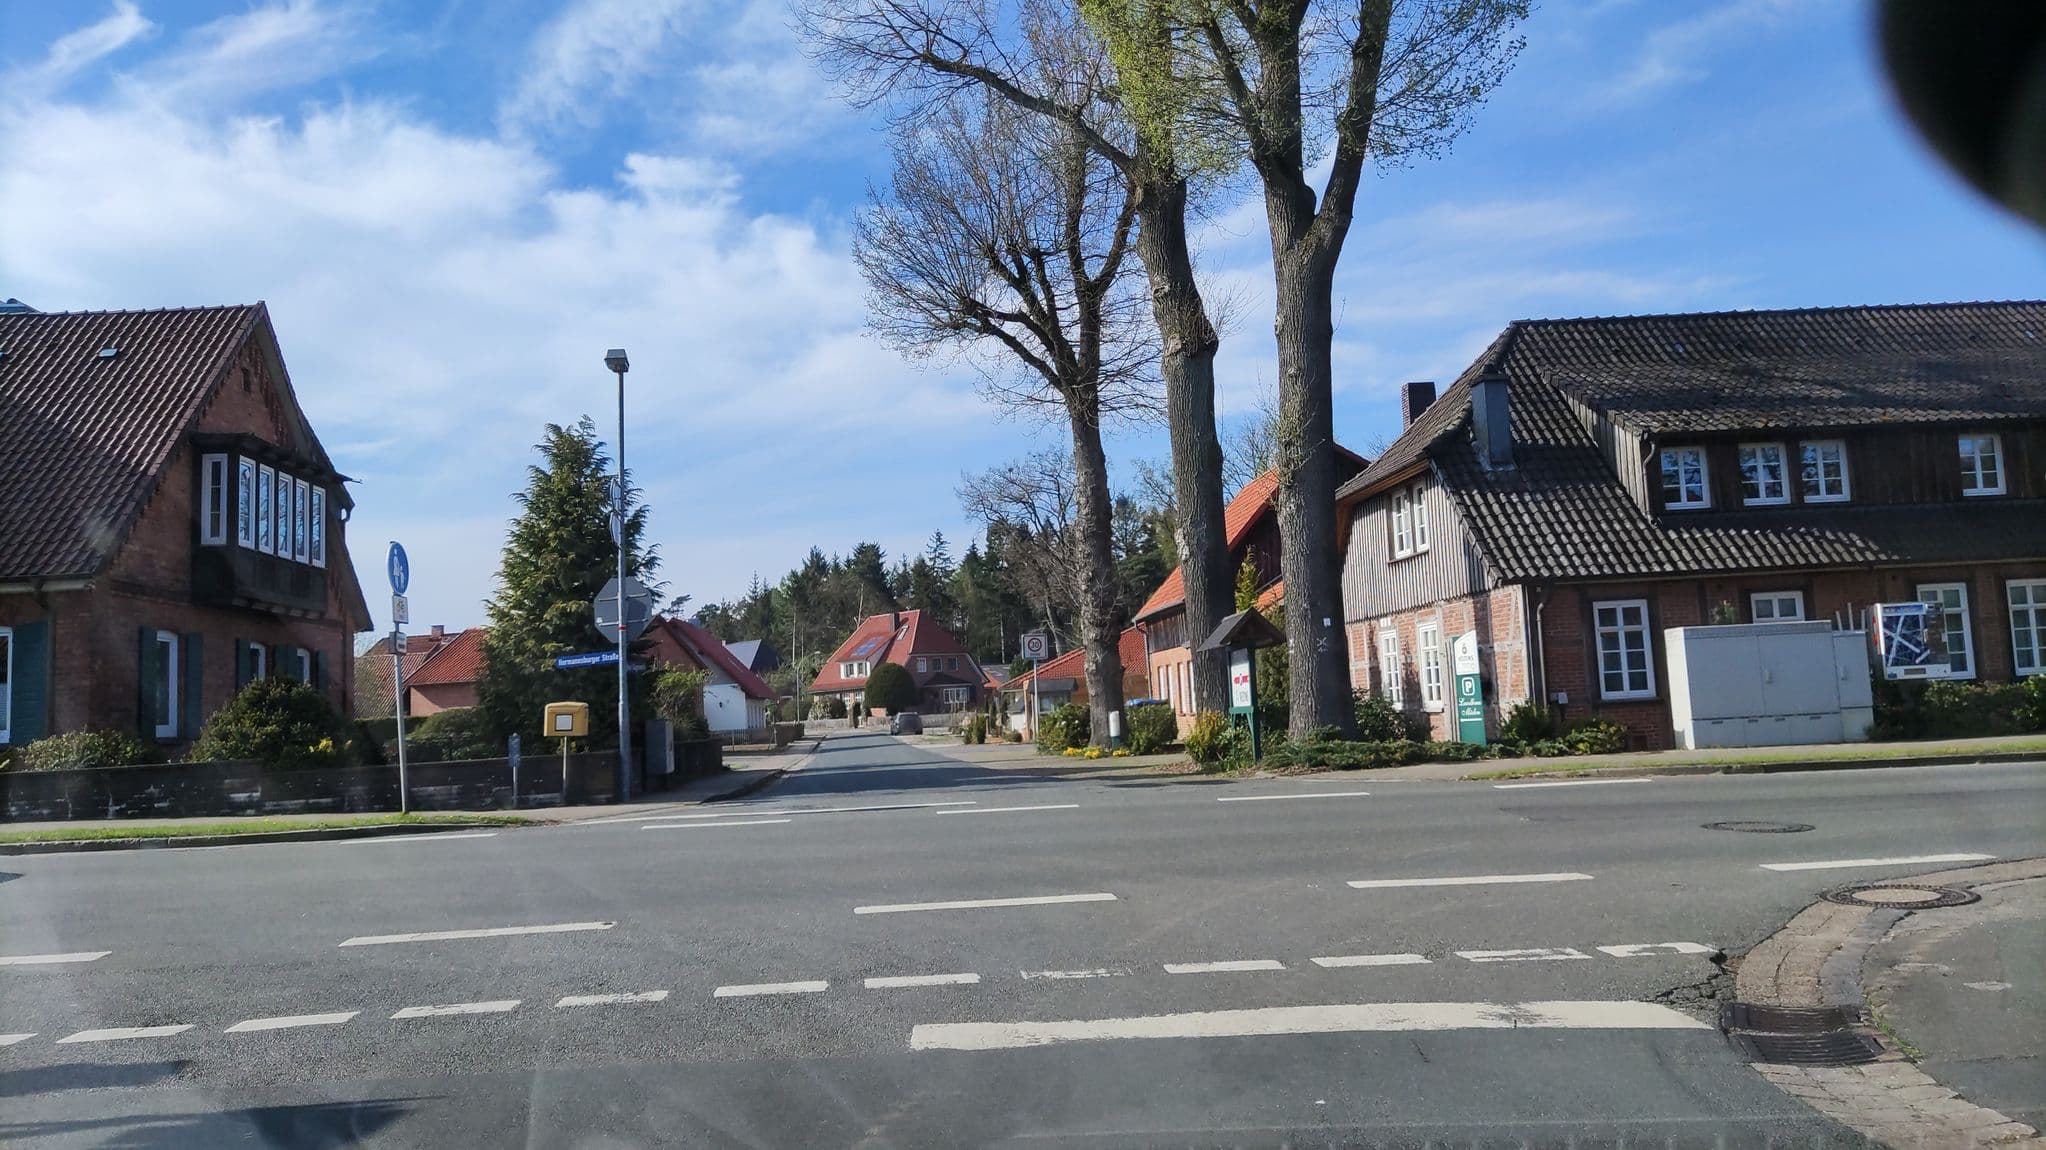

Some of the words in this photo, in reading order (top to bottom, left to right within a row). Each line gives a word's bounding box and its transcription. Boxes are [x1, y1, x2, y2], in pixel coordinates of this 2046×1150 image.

[1030, 641, 1040, 649] 30
[602, 652, 619, 661] Straße
[1465, 681, 1472, 692] P
